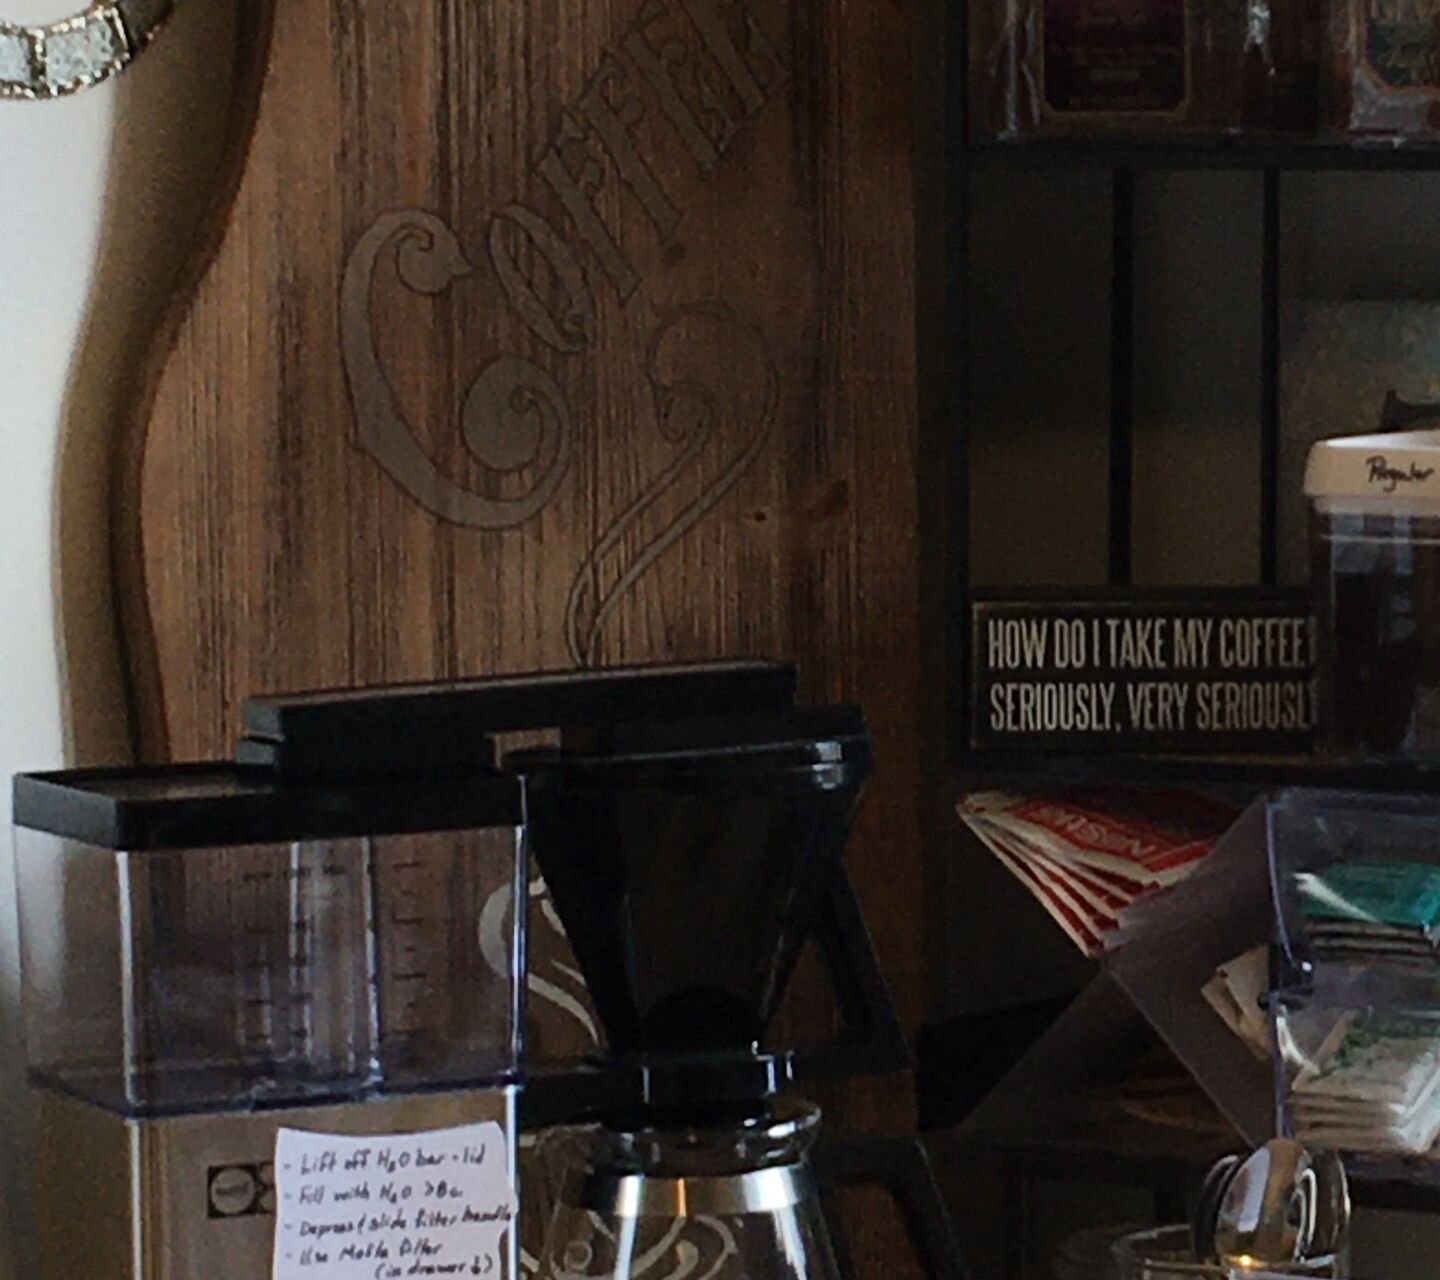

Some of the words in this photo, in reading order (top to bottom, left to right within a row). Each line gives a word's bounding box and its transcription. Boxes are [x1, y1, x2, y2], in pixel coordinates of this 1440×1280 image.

[988, 619, 1047, 668] HOW
[1055, 619, 1086, 668] DO
[1092, 619, 1100, 668] I
[1105, 619, 1167, 668] TAKE
[1173, 619, 1213, 668] MY
[1127, 682, 1189, 731] VERY
[301, 1151, 337, 1175] Lift
[344, 1150, 370, 1168] off
[464, 1144, 486, 1165] lid
[300, 1186, 324, 1204] Fill
[334, 1182, 370, 1201] with
[369, 1210, 407, 1231] slide
